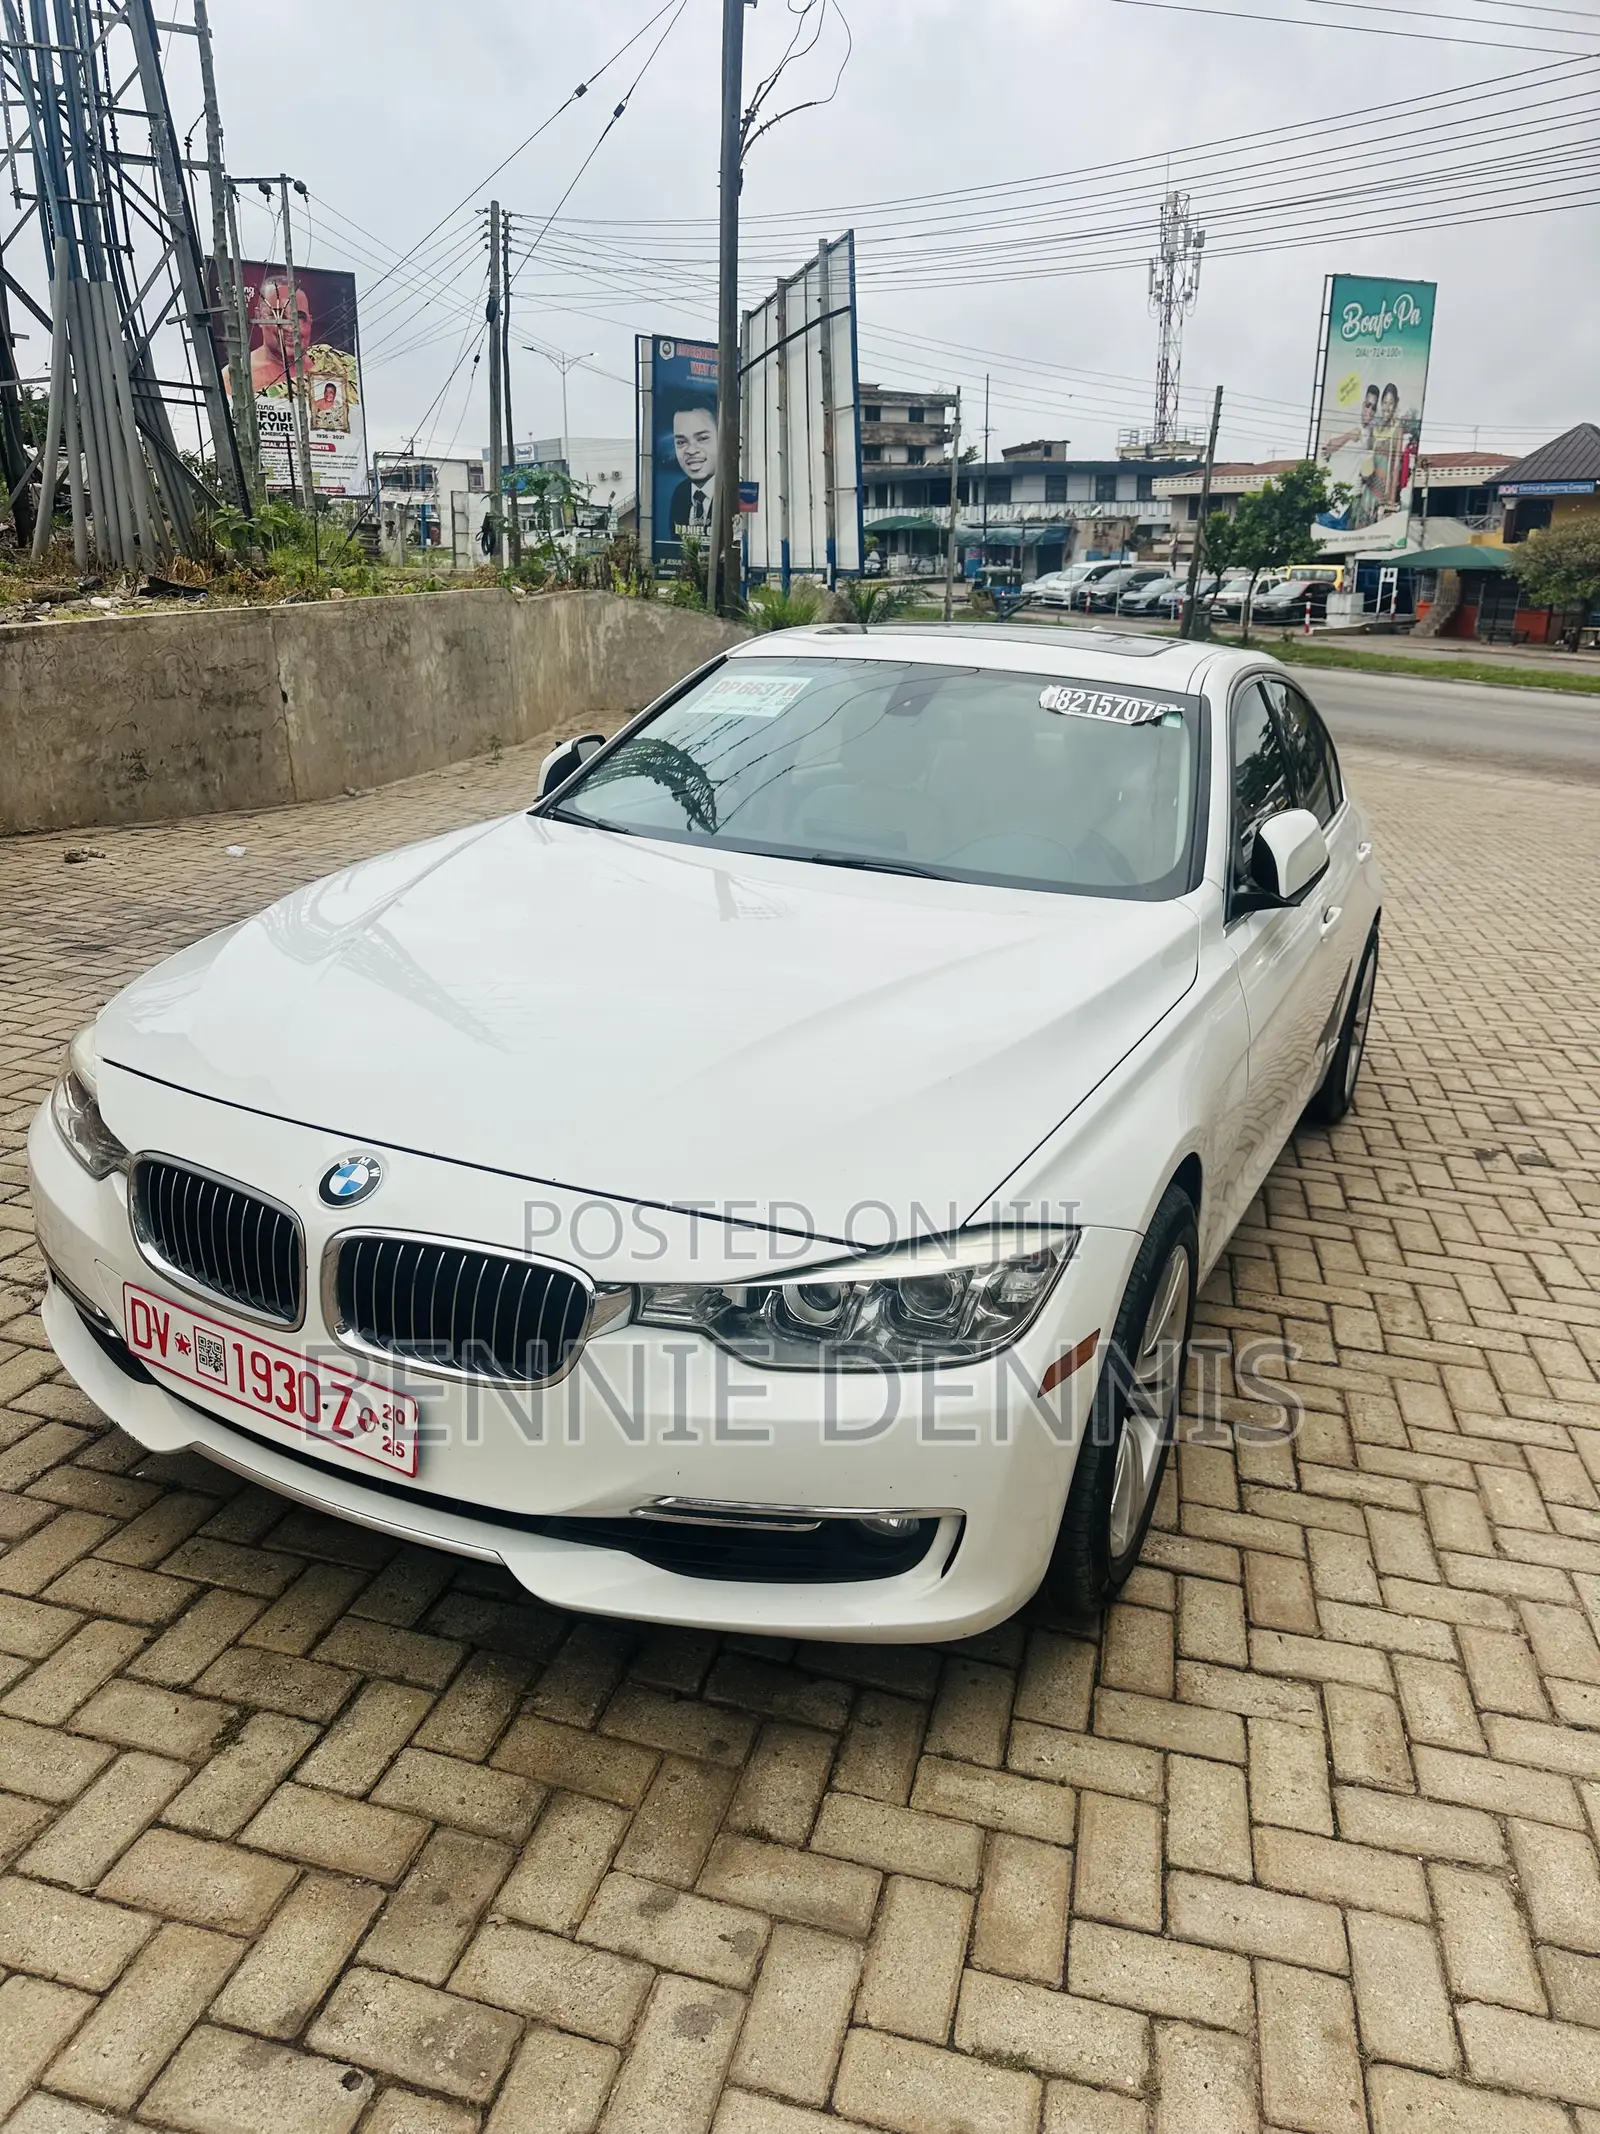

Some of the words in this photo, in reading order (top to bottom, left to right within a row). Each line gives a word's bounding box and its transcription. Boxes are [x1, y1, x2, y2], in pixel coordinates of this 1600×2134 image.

[1342, 302, 1393, 339] Boafo
[1393, 293, 1421, 330] Pa
[340, 1157, 380, 1177] BMW
[131, 1297, 170, 1357] DV
